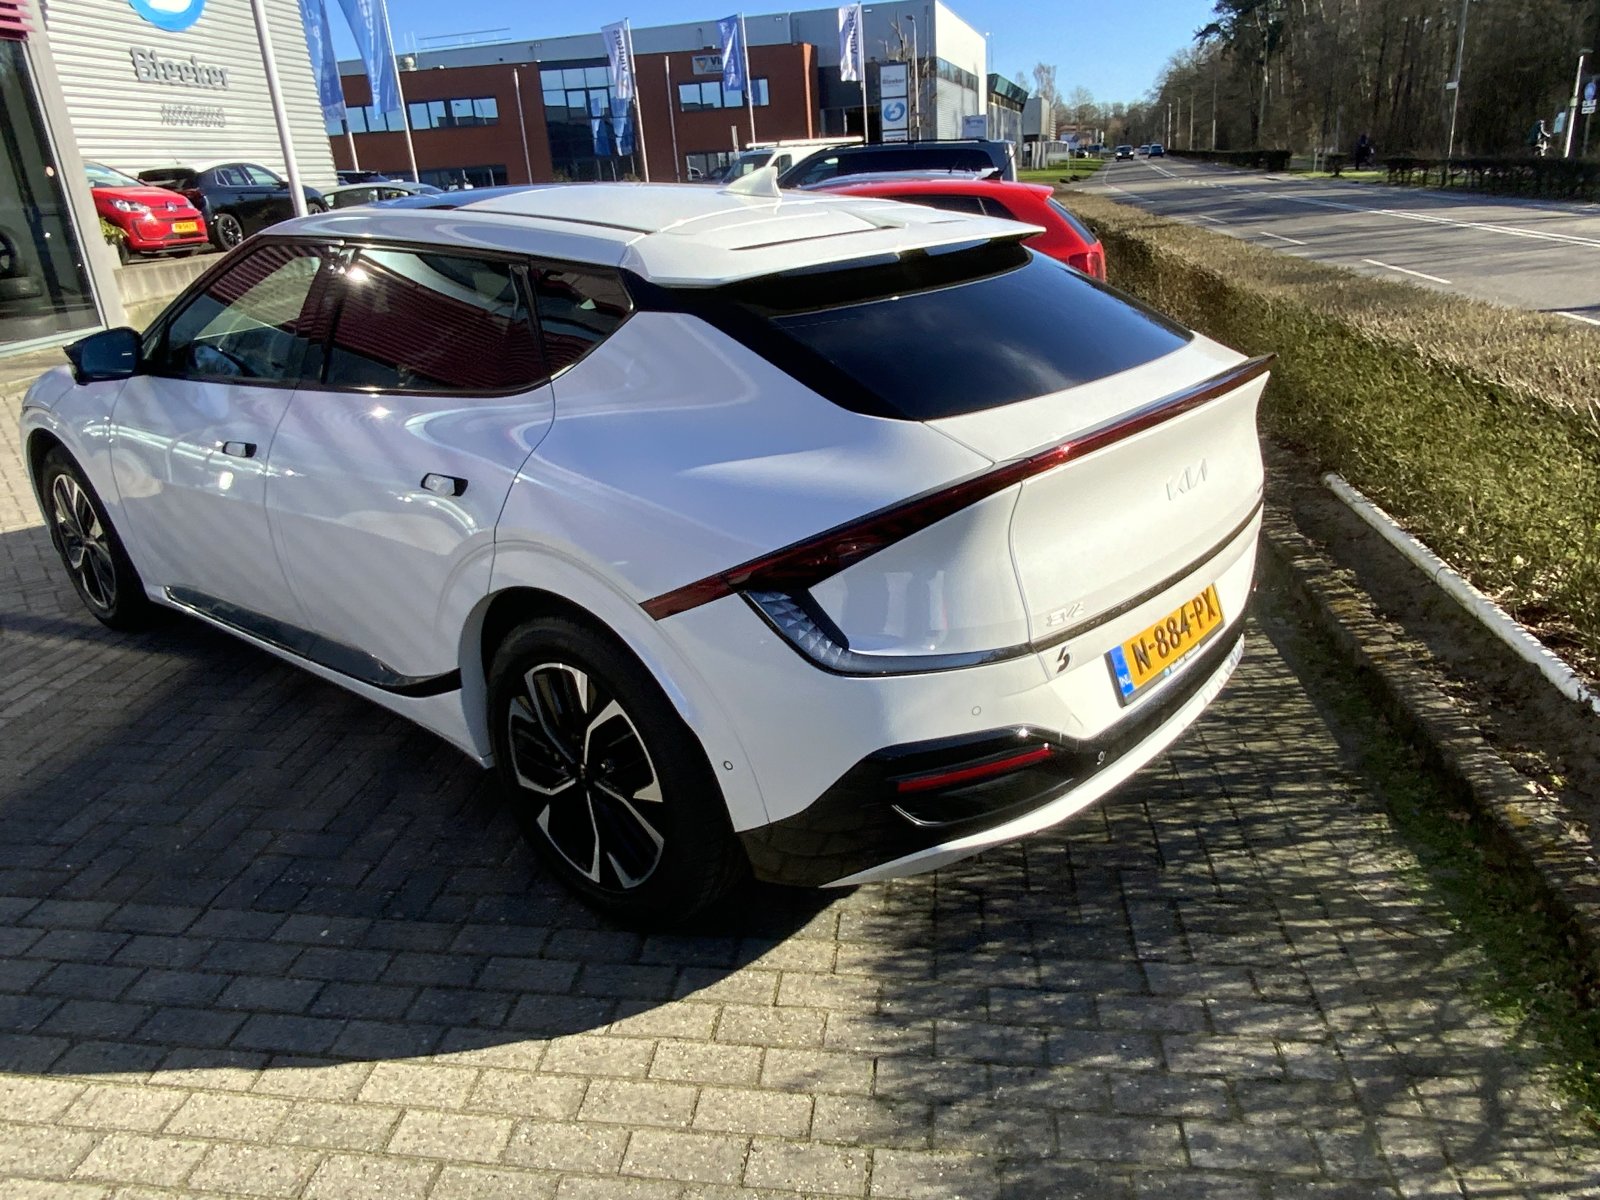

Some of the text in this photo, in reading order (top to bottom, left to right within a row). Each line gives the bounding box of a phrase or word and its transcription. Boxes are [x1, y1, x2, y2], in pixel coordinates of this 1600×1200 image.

[130, 47, 229, 91] Bleeker
[1166, 458, 1208, 501] KIA
[1131, 587, 1216, 676] N-884-PX
